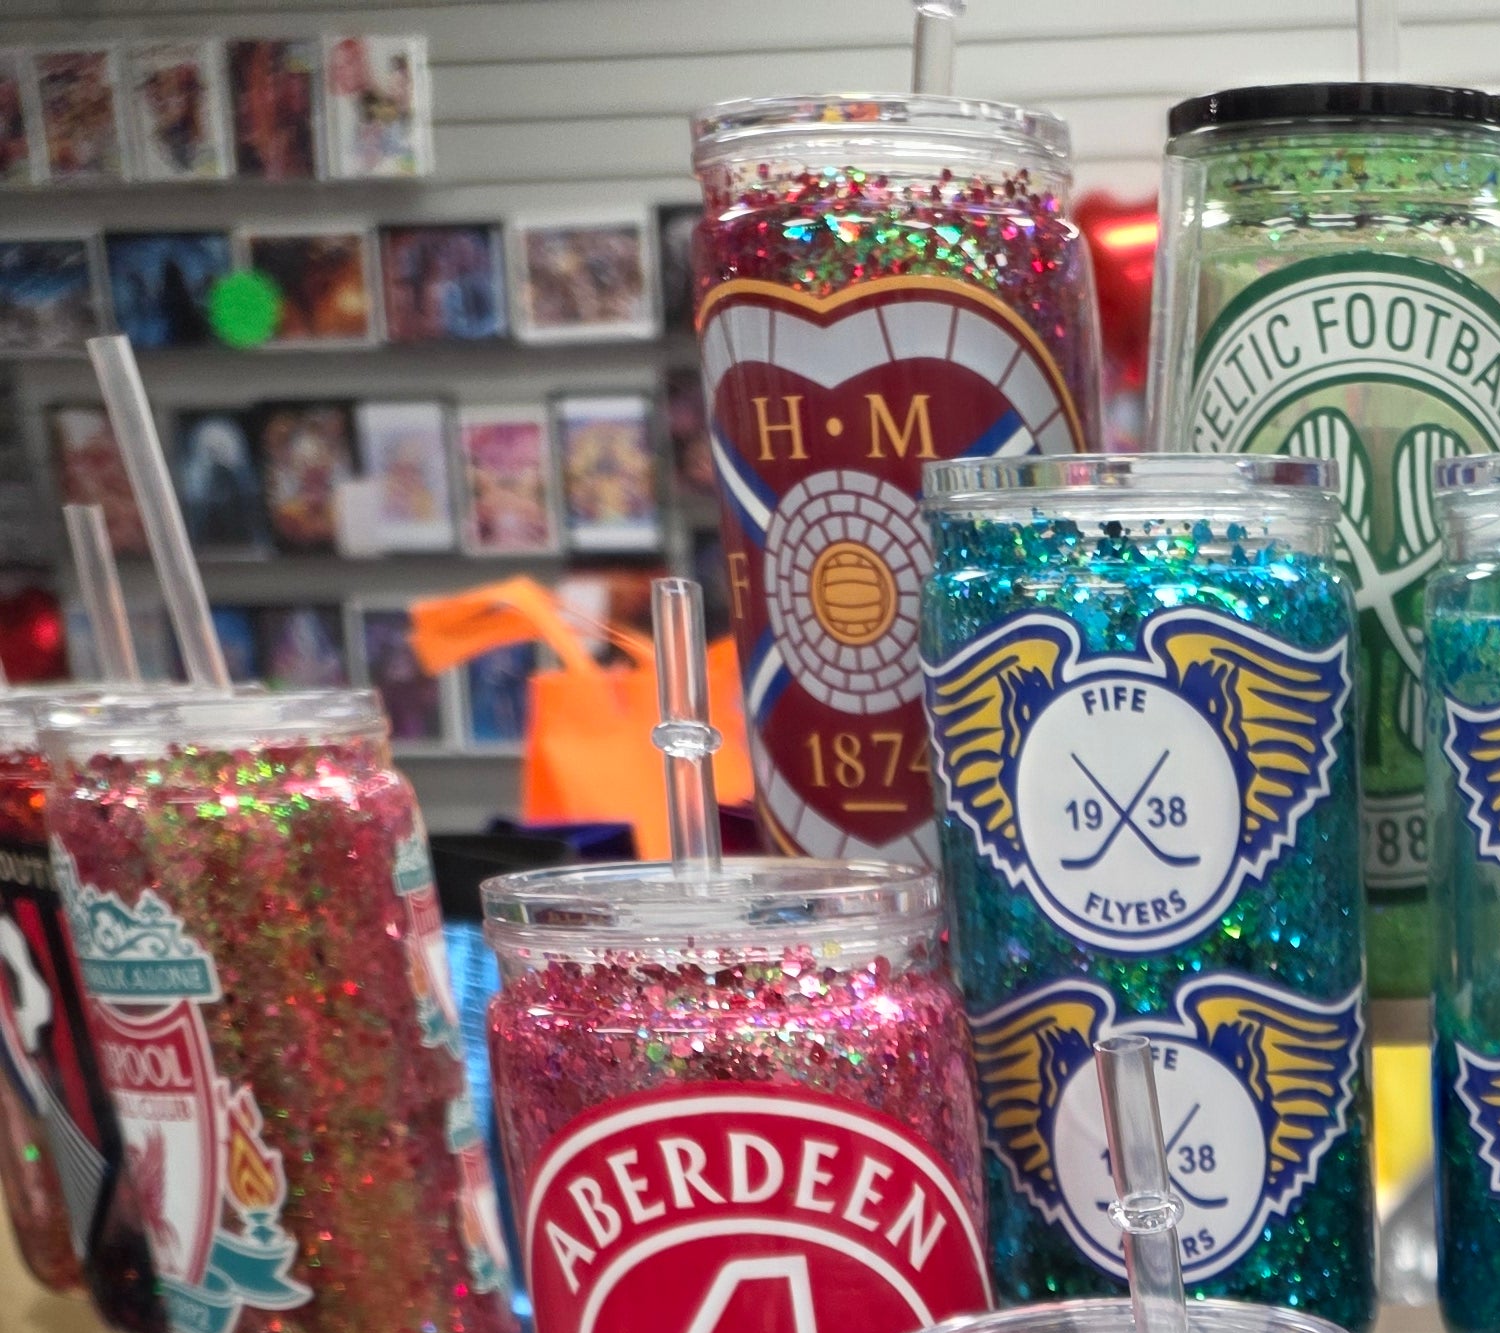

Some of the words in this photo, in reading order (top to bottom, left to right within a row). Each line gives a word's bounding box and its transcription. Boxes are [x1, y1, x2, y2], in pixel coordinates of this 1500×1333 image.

[1081, 686, 1148, 716] FIFE
[805, 731, 931, 788] 1874
[1064, 799, 1104, 832] 19
[1147, 796, 1188, 829] 38
[1366, 815, 1428, 867] 88
[1085, 890, 1188, 927] FLYERS
[1178, 1145, 1216, 1174] 38
[544, 1132, 947, 1294] ABERDEEN
